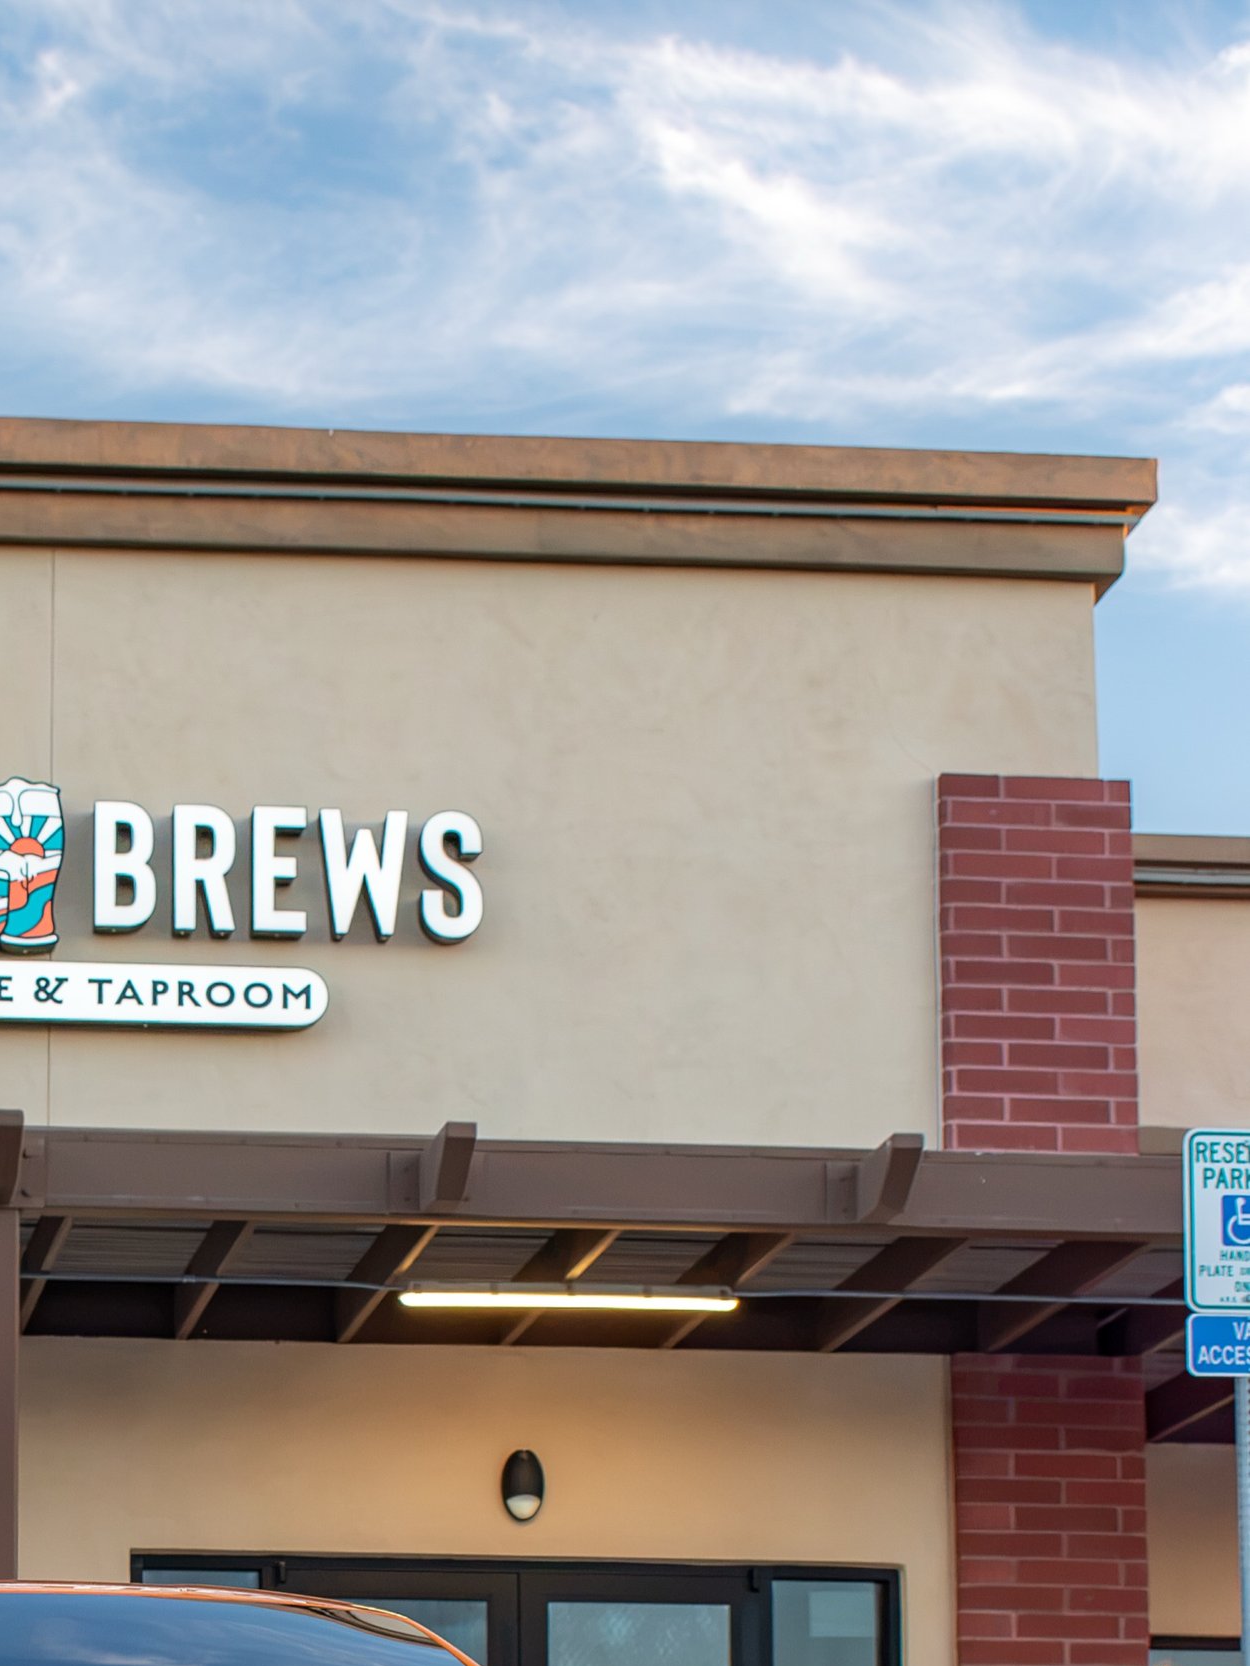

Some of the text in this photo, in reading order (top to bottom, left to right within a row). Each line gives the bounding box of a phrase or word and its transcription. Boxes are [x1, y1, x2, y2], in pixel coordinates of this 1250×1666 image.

[93, 800, 484, 942] BREWS
[33, 976, 69, 1004] &
[88, 979, 312, 1010] TAPROOM
[1196, 1142, 1250, 1164] RESE
[1199, 1265, 1234, 1277] PLATE
